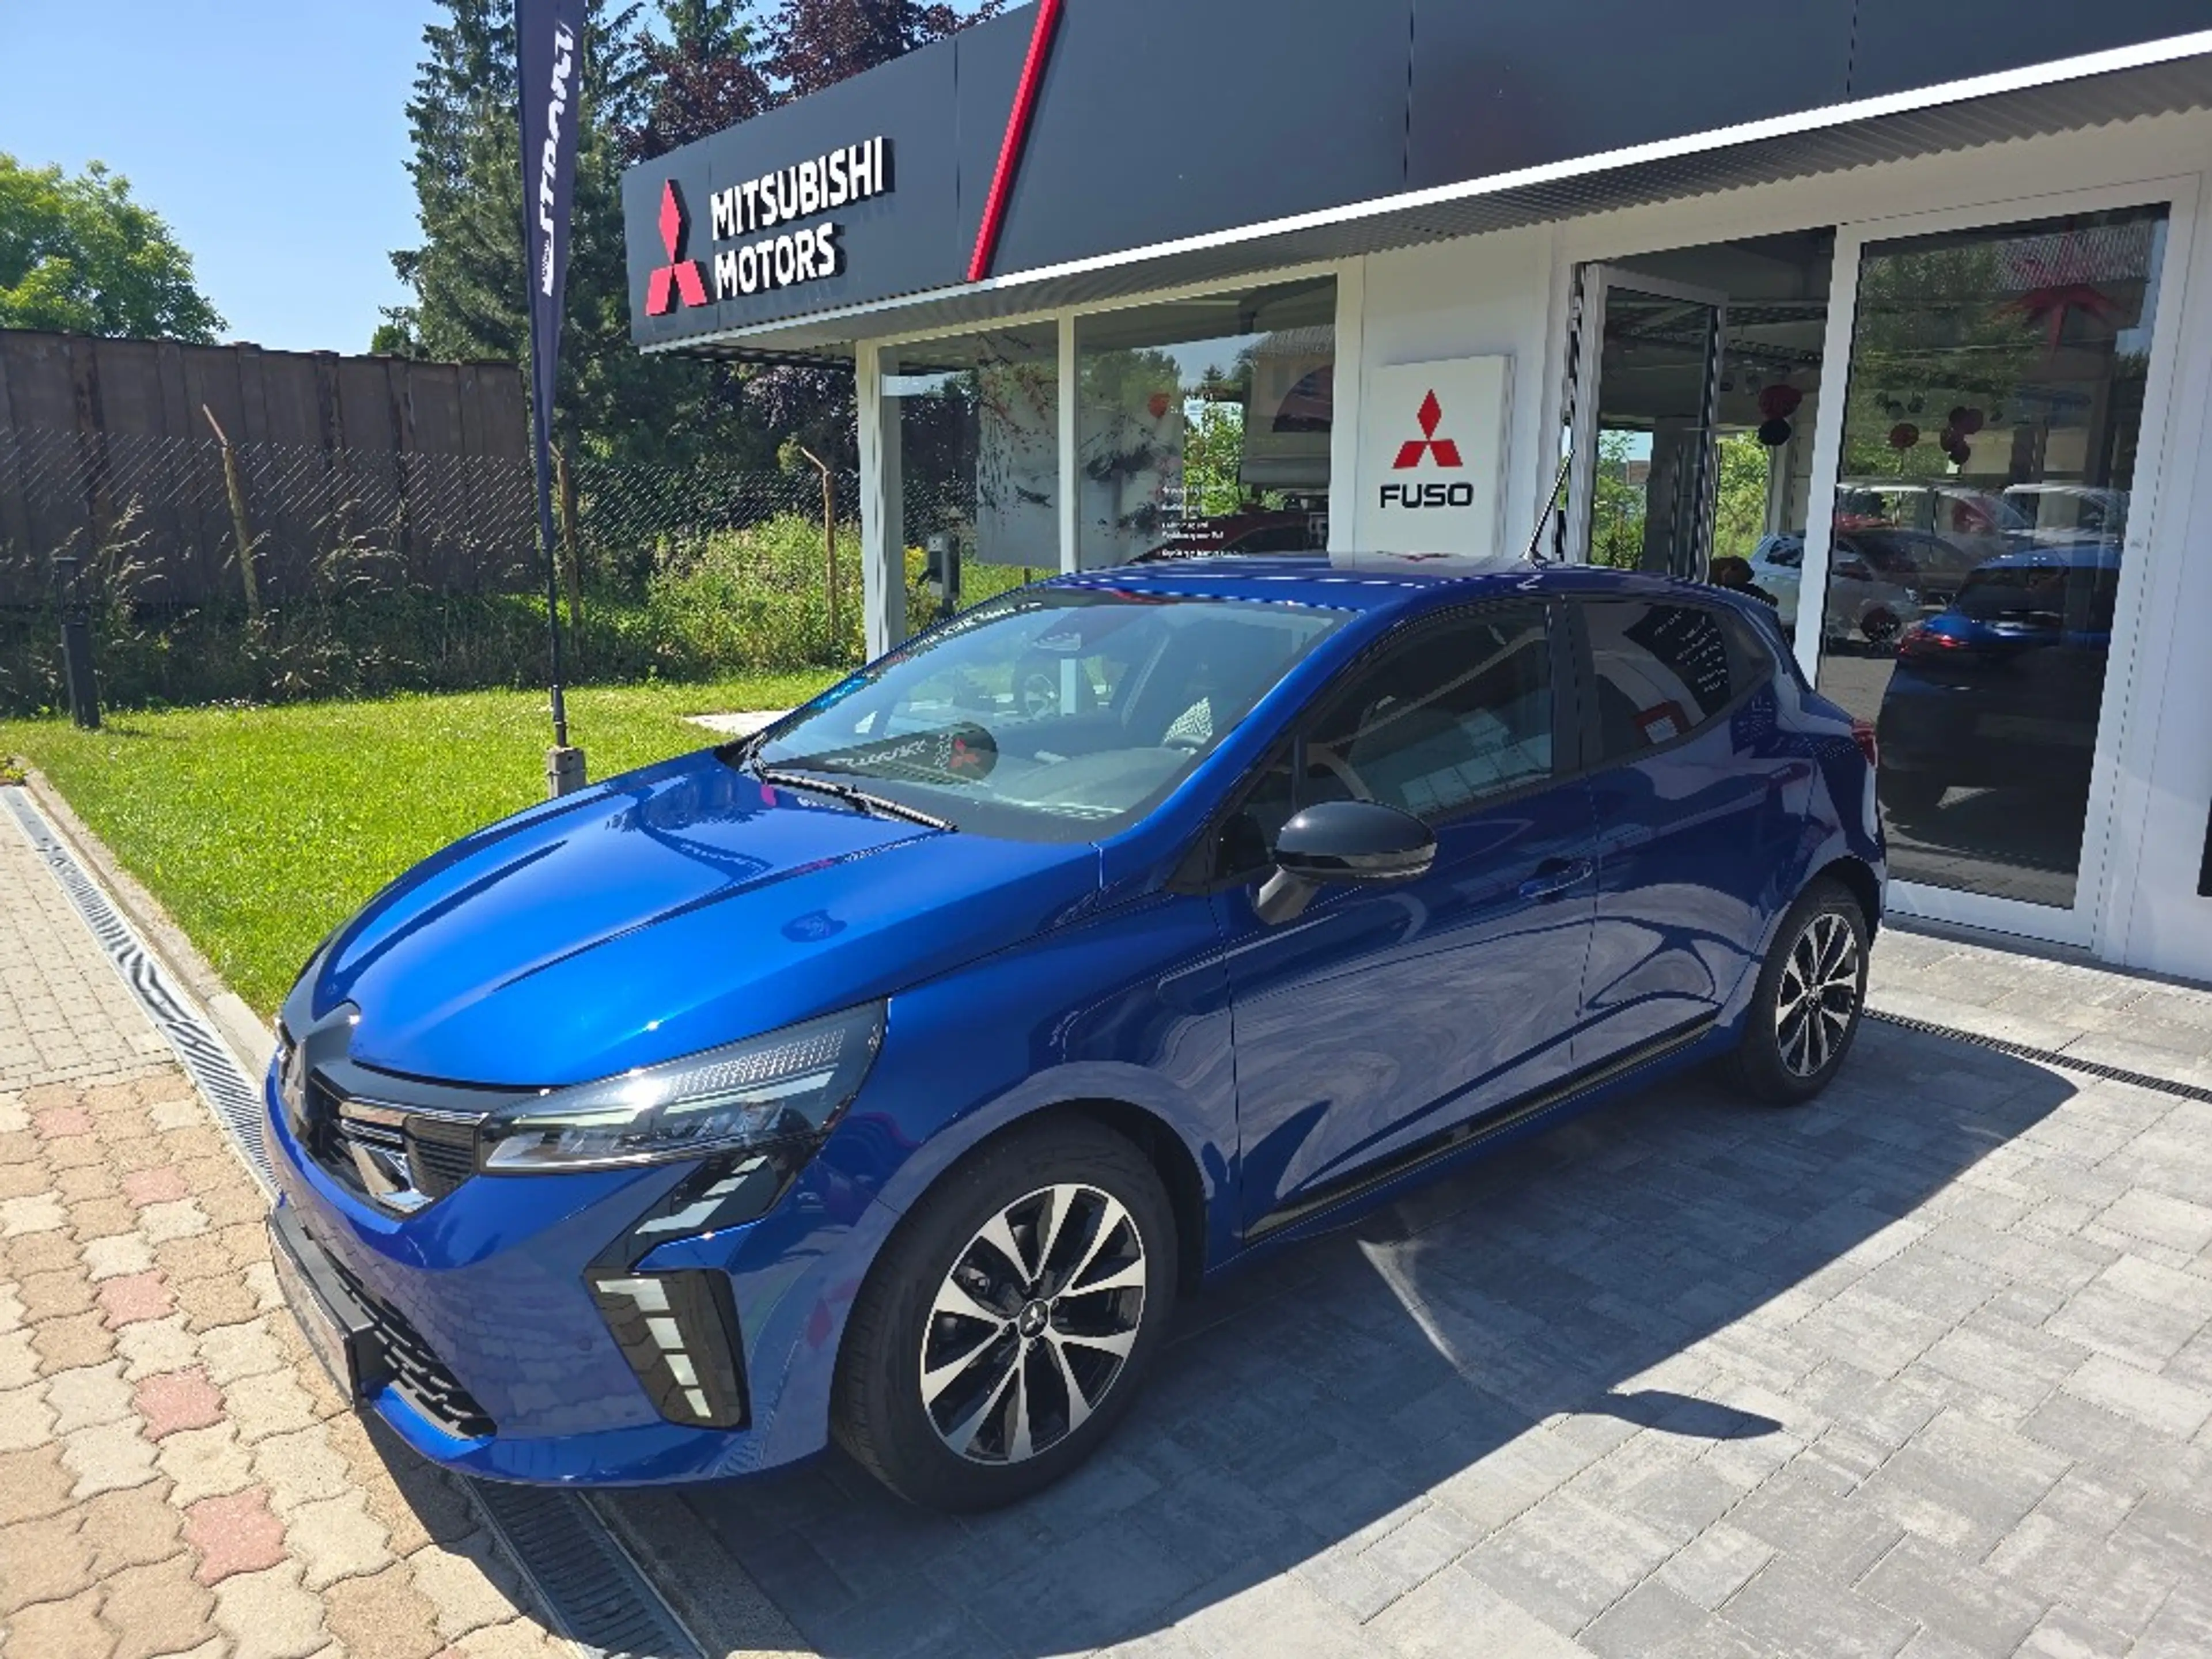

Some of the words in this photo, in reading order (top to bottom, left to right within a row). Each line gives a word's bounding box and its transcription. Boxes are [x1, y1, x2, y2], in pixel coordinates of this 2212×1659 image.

[710, 136, 883, 241] MITSUBISHI
[714, 222, 836, 300] MOTORS
[1380, 482, 1474, 508] FUSO
